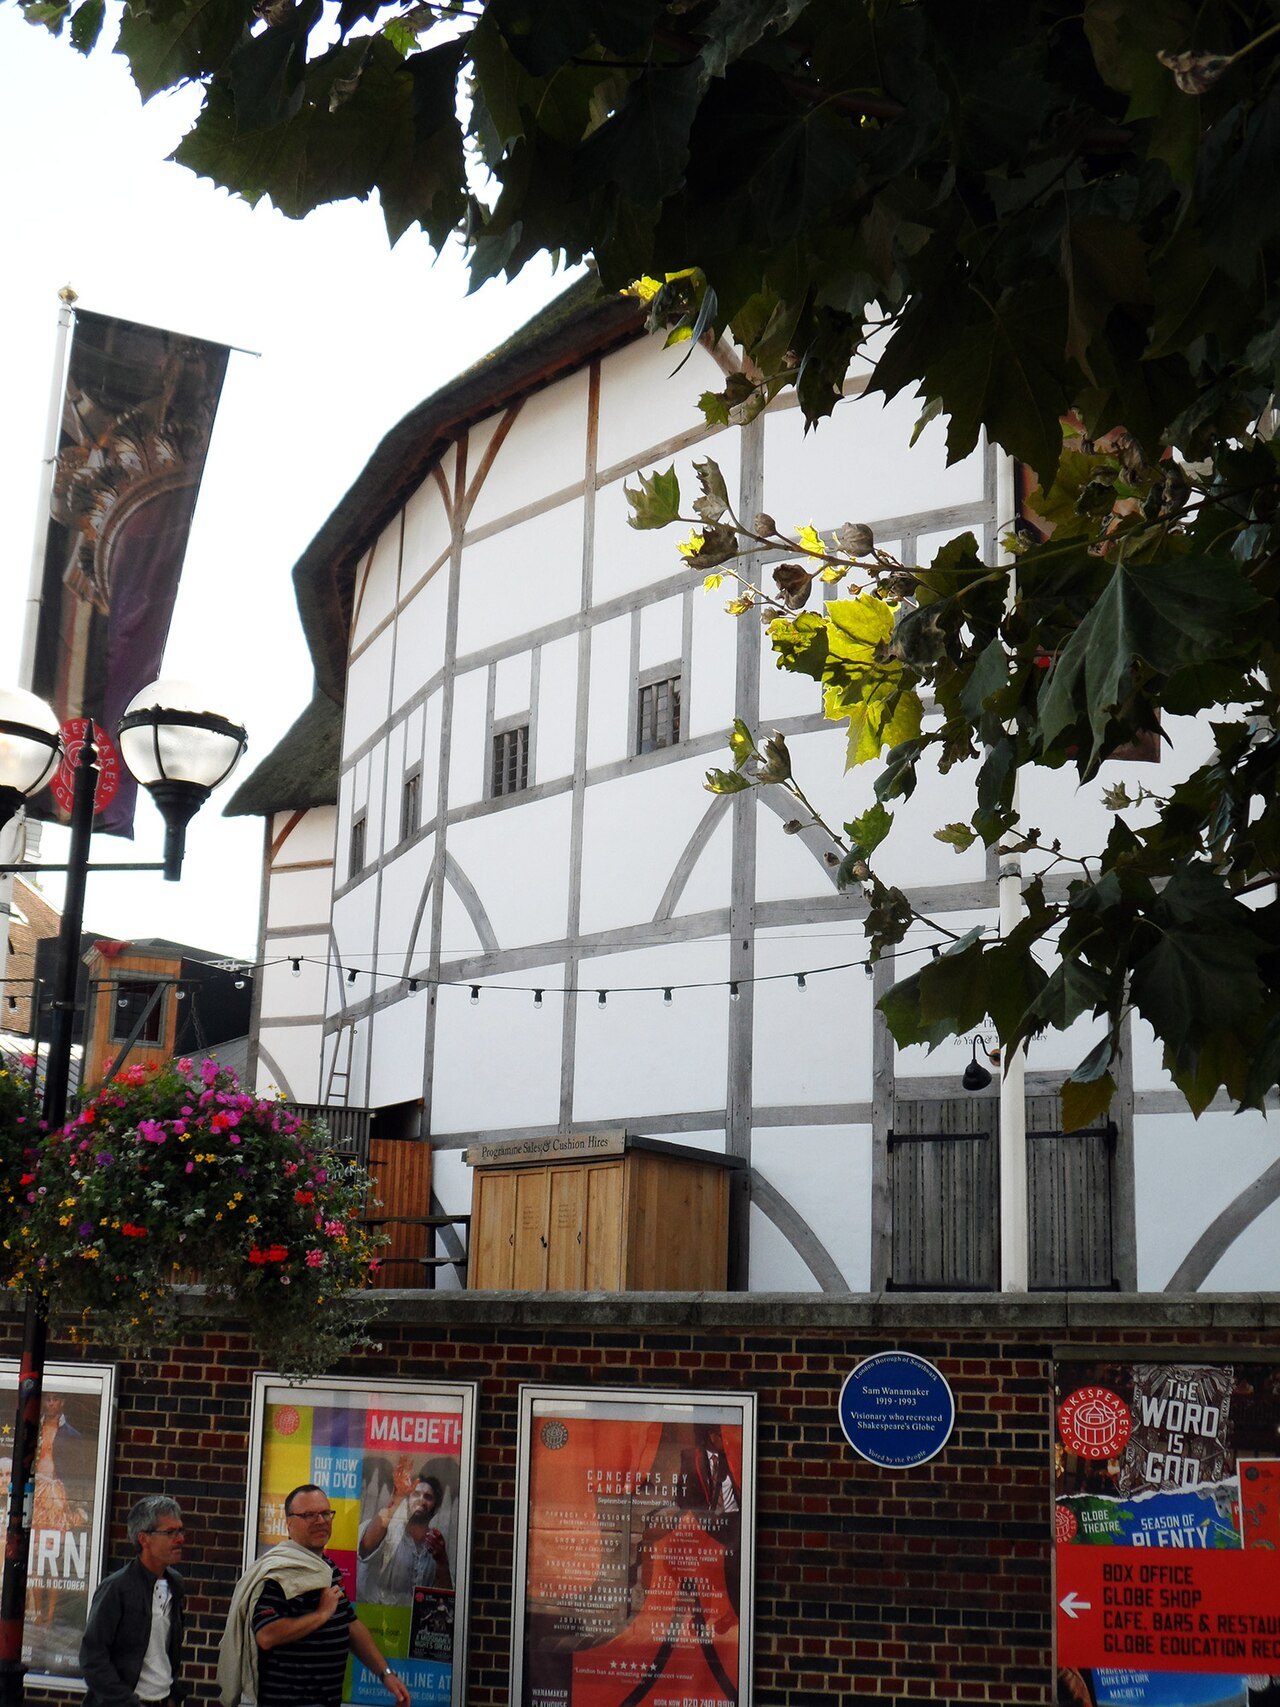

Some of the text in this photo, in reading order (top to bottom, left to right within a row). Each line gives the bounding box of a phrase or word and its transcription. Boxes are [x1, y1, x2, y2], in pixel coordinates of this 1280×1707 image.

[481, 1145, 523, 1160] Programme
[542, 1139, 552, 1152] &
[552, 1139, 585, 1151] Cushion
[588, 1135, 608, 1147] Hires
[854, 1355, 938, 1382] London Borough of Southwark
[862, 1386, 930, 1398] Sam Wanamaker
[1167, 1379, 1198, 1402] THE
[876, 1397, 893, 1406] 1919
[899, 1398, 917, 1407] 1993
[850, 1411, 943, 1423] Visionary who recreated
[1061, 1388, 1129, 1436] SHAKESPEARE'S
[1142, 1395, 1219, 1439] WORD
[857, 1421, 936, 1432] Shakespeare's Globe
[1073, 1440, 1119, 1457] GLOBE
[1168, 1433, 1184, 1454] IS
[868, 1448, 885, 1461] Voted
[894, 1454, 905, 1464] the
[906, 1449, 927, 1463] People
[315, 1457, 360, 1473] OUT NOW
[1145, 1452, 1200, 1490] GOD
[314, 1473, 358, 1489] ON DVD
[586, 1470, 689, 1485] CONCERTS BY
[586, 1483, 688, 1498] CANDLELIGHT
[597, 1497, 628, 1507] September
[632, 1499, 662, 1507] November
[1081, 1509, 1109, 1522] GLOBE
[1140, 1514, 1195, 1531] SEASON OF
[1083, 1521, 1120, 1534] THEATRE
[1103, 1563, 1194, 1585] BOX OFFICE
[53, 1579, 86, 1591] OCTOBER
[1103, 1586, 1202, 1609] GLOBE SHOP
[1152, 1612, 1193, 1633] BARS
[1199, 1614, 1211, 1633] &
[1217, 1615, 1280, 1635] RESTAU
[1104, 1633, 1154, 1654] GLOBE
[1160, 1635, 1246, 1657] EDUCATION
[438, 1674, 452, 1690] AT
[1101, 1675, 1120, 1686] DUKE
[1121, 1674, 1130, 1685] OF
[531, 1688, 568, 1698] WANAMAKER
[1109, 1687, 1147, 1699] MACBETH
[683, 1697, 698, 1707] 020
